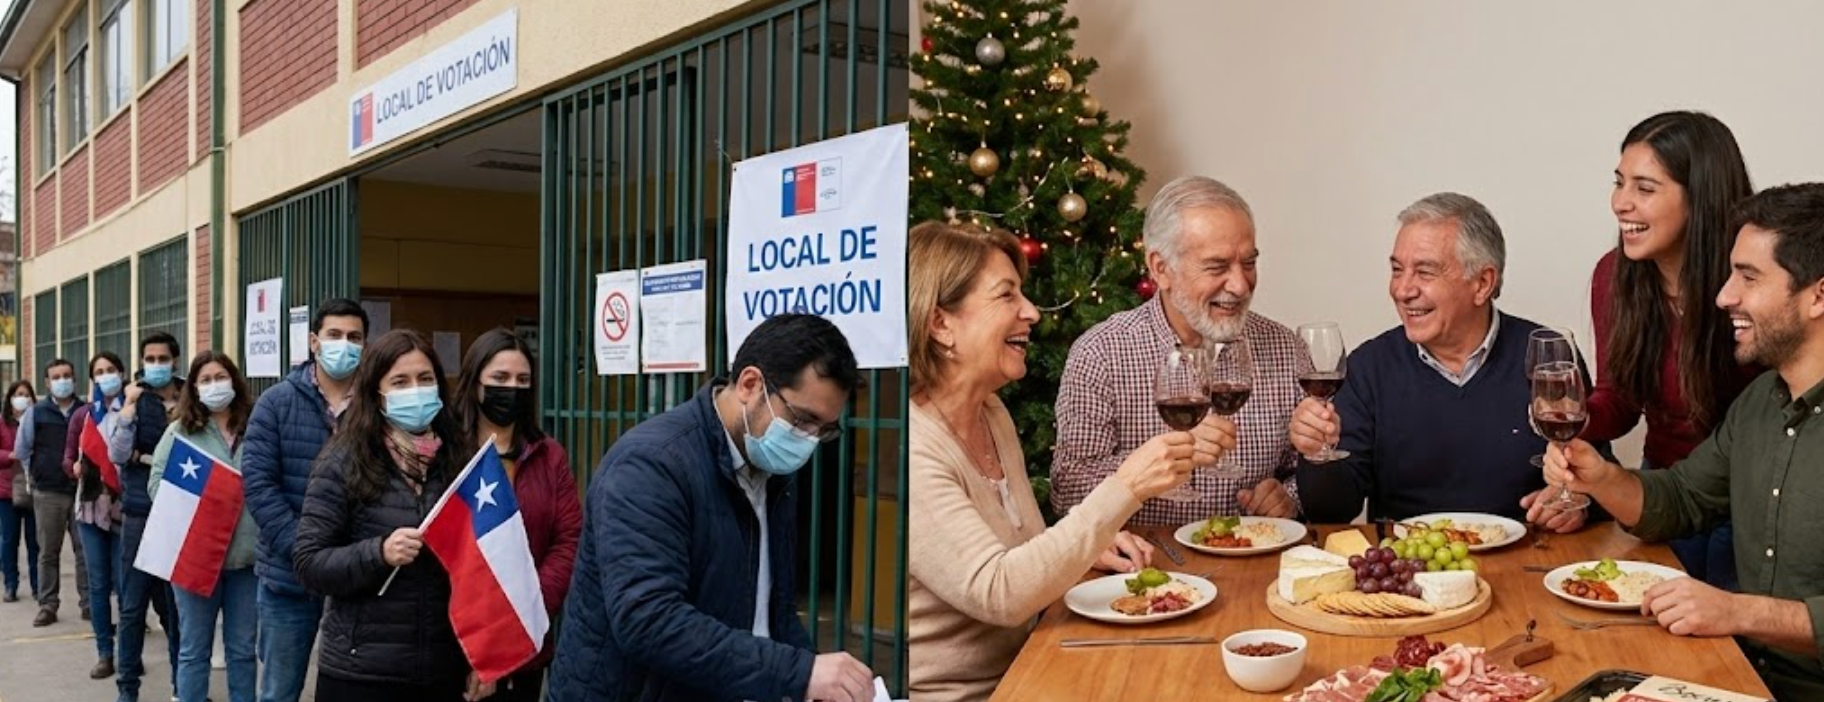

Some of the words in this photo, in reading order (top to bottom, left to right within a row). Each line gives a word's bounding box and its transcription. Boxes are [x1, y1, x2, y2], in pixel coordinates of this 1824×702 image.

[376, 86, 414, 124] LOCAL
[416, 74, 434, 106] DE
[436, 36, 510, 95] VOTACIÓN
[748, 233, 830, 273] LOCAL
[840, 225, 877, 262] DE
[743, 271, 881, 320] VOTACIÓN
